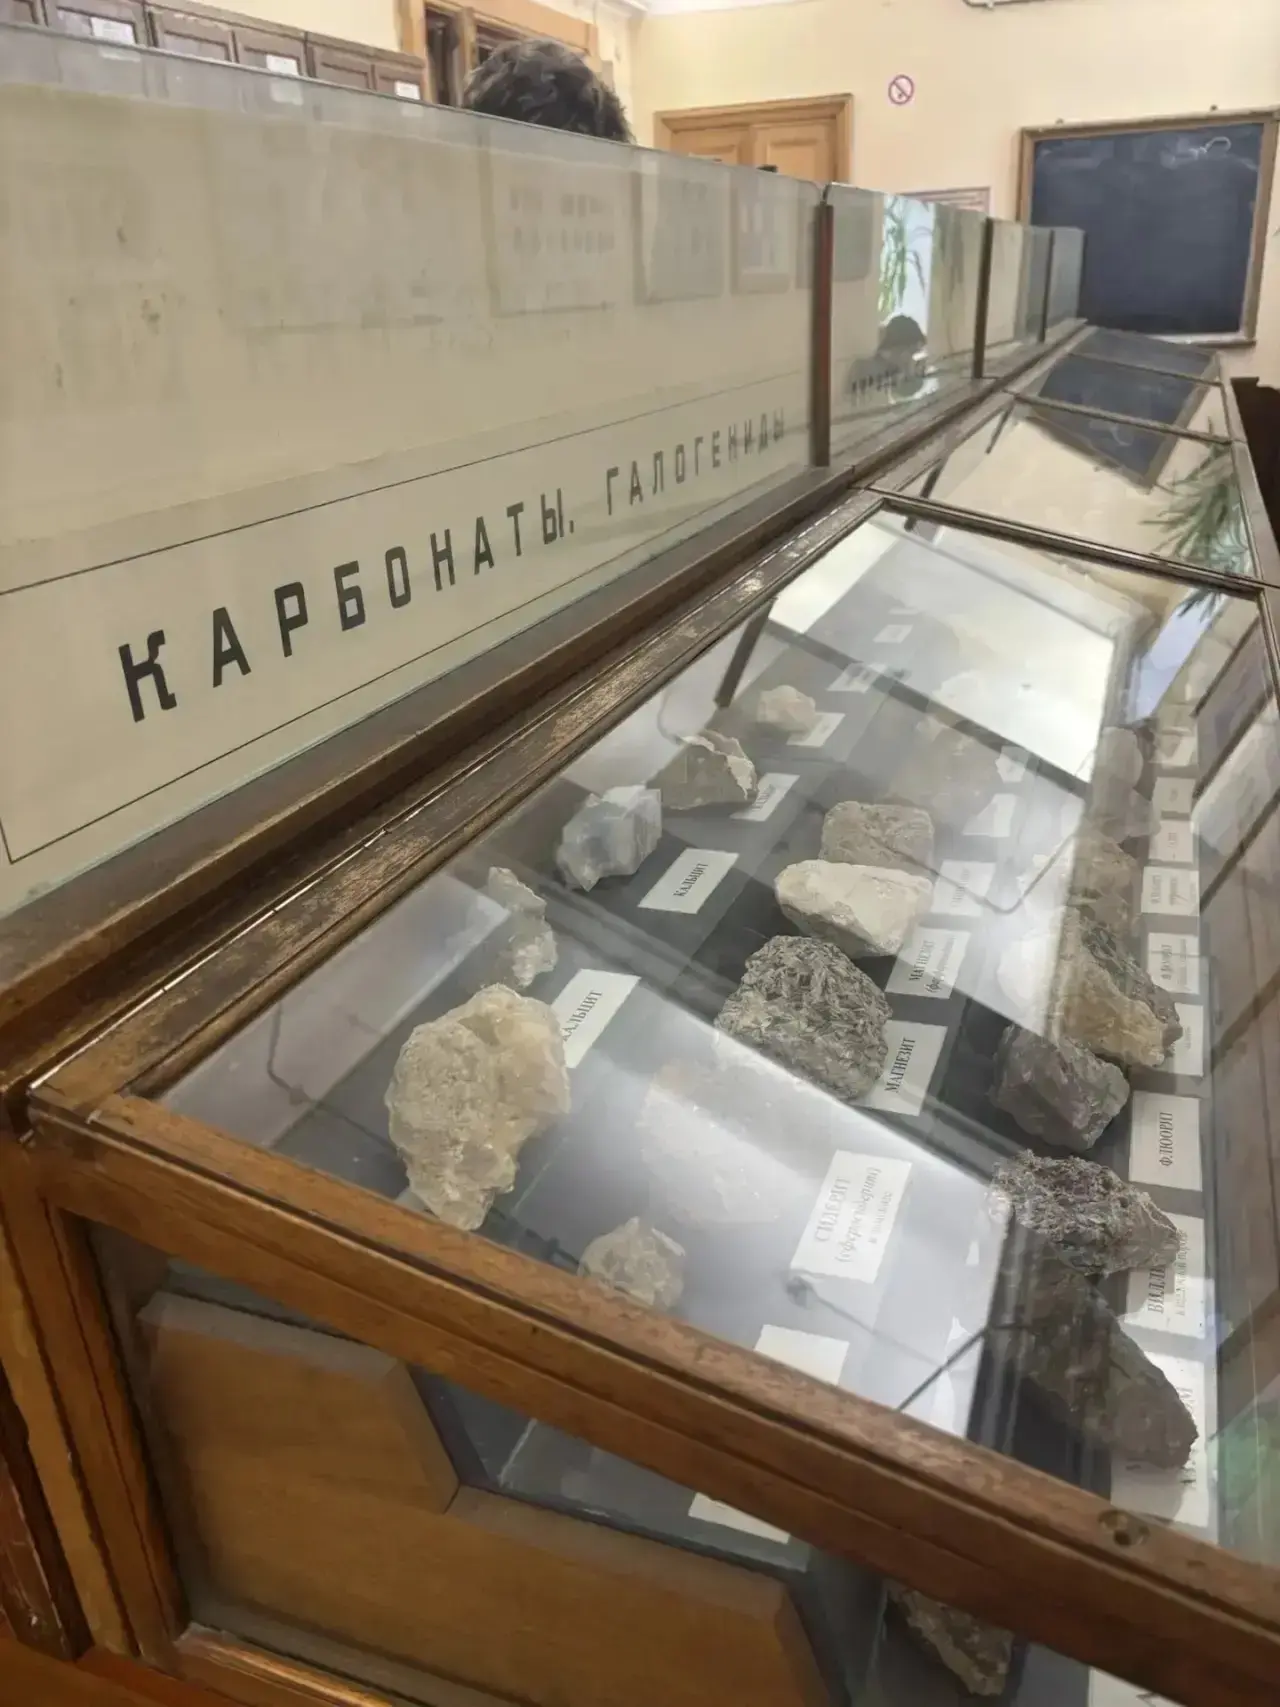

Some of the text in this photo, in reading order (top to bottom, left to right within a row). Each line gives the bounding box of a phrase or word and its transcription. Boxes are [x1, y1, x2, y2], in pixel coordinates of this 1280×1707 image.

[606, 406, 785, 516] ГАЛОГЕНИДЫ
[672, 863, 709, 897] КАЛЬЦИТ
[884, 1036, 916, 1093] МАГНЕЗИТ
[1159, 1111, 1173, 1167] ФЛЮОРИТ
